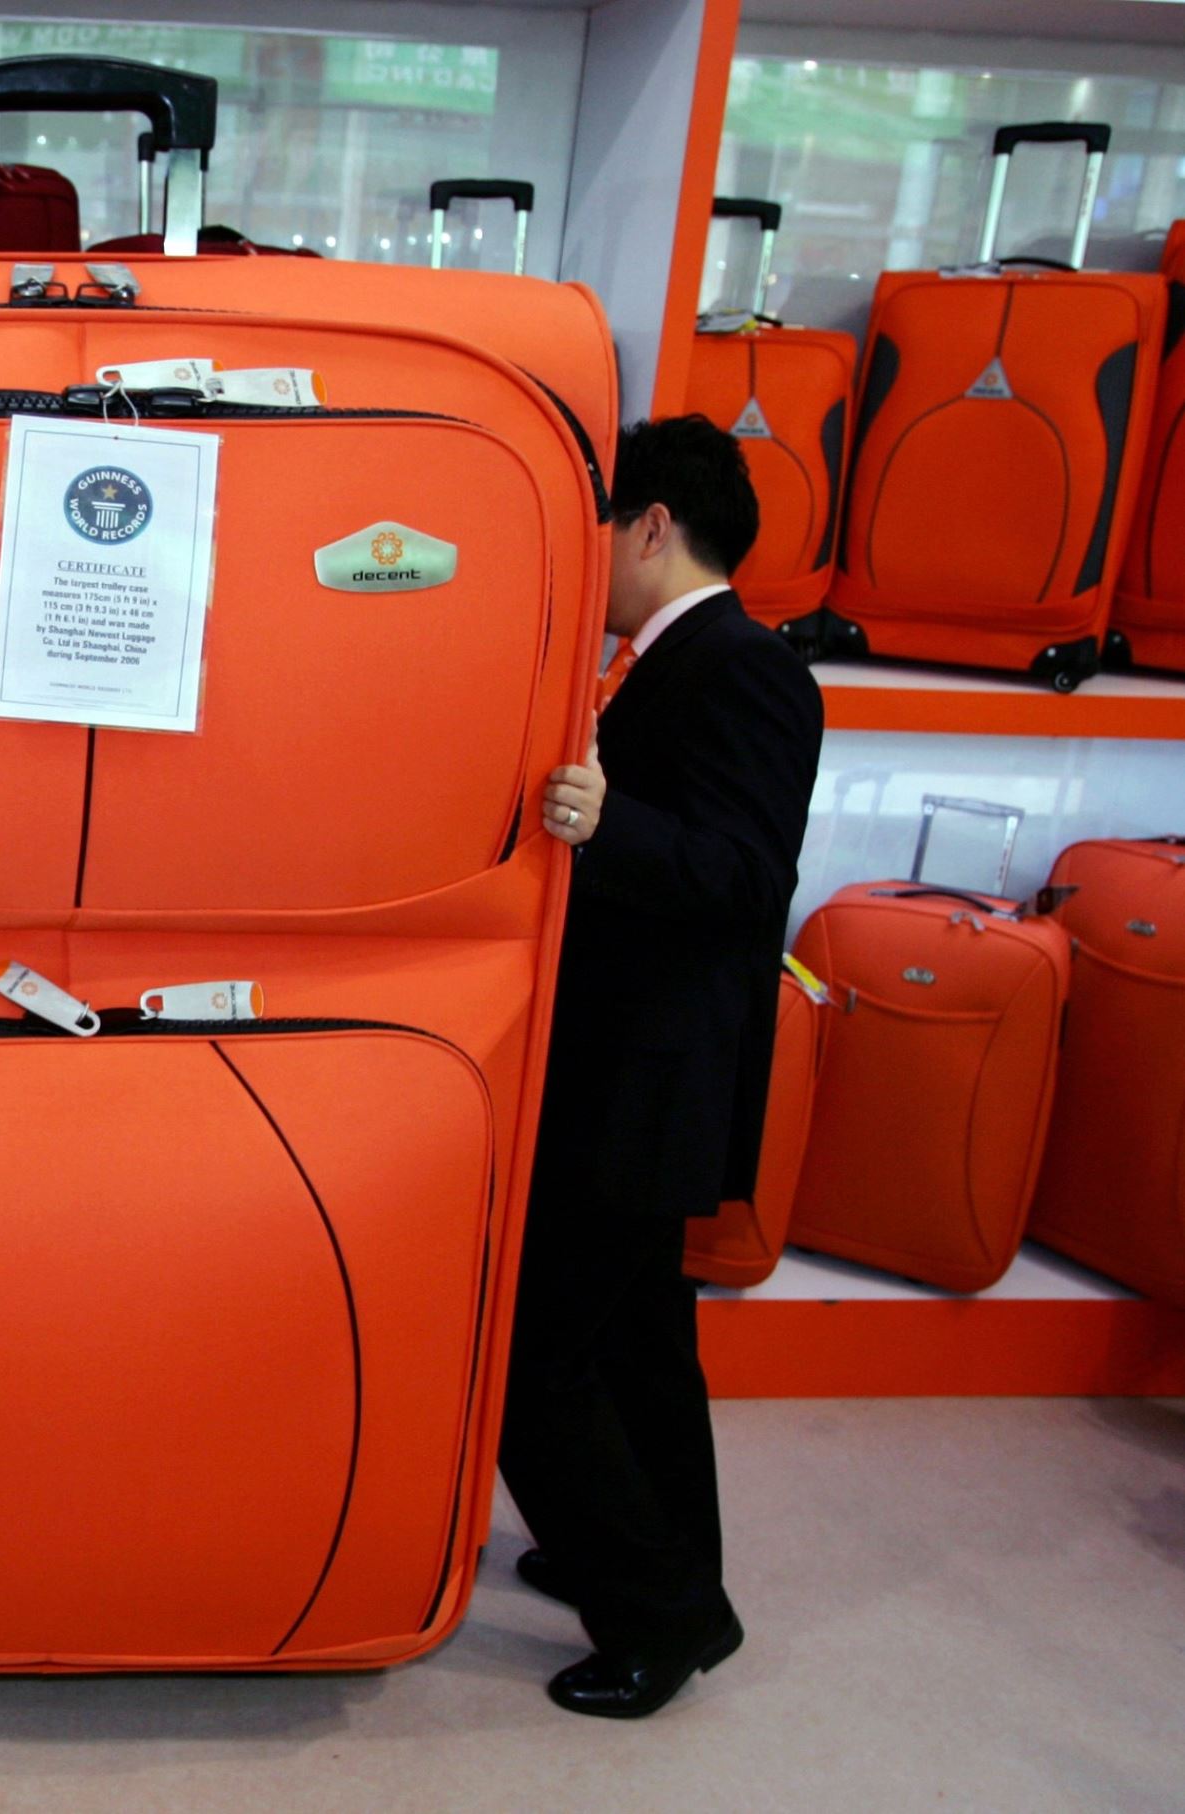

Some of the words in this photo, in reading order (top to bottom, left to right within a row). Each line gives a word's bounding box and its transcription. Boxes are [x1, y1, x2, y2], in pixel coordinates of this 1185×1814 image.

[78, 471, 142, 495] GUINNESS
[70, 498, 98, 537] WORLD
[102, 504, 147, 540] RECORDS
[57, 560, 146, 576] CERTIFICATE
[352, 568, 420, 582] decent
[54, 577, 68, 587] The
[71, 579, 99, 590] largest
[101, 582, 127, 593] trolley
[129, 585, 148, 593] case
[42, 590, 81, 600] measures
[84, 592, 111, 602] 175cm
[43, 601, 58, 610] 115
[60, 603, 73, 611] cm
[141, 610, 154, 618] cm
[91, 618, 106, 626] and
[108, 620, 125, 628] was
[128, 621, 150, 630] made
[36, 624, 46, 634] by
[48, 625, 86, 637] Shanghai
[88, 629, 120, 639] Newest
[122, 632, 156, 643] Luggage
[58, 638, 71, 647] Ltd
[73, 640, 80, 648] in
[124, 644, 147, 654] China
[47, 649, 72, 660] during
[75, 651, 118, 664] September
[120, 656, 140, 665] 2006
